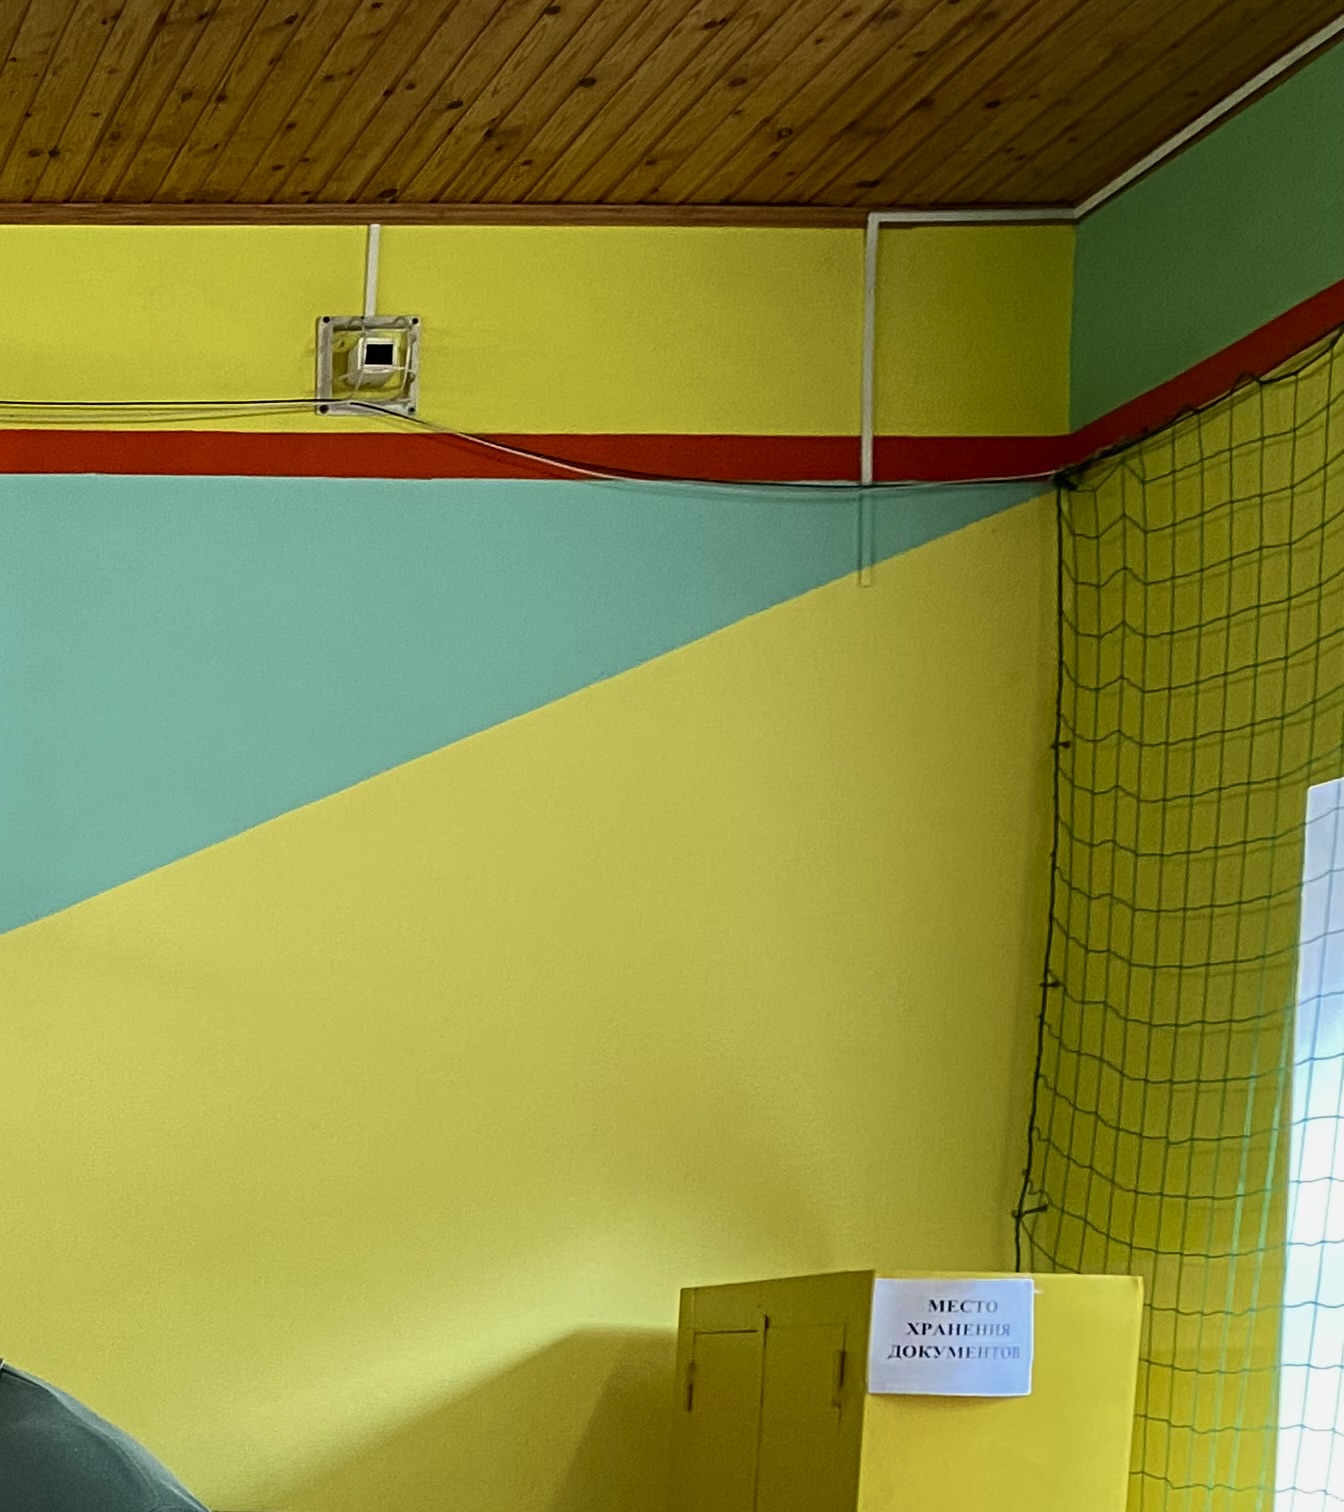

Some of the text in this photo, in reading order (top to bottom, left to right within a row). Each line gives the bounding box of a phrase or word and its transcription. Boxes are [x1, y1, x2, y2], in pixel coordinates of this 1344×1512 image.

[928, 1299, 998, 1313] МЕСТО
[907, 1322, 1011, 1336] ХРАНЕНИЯ
[887, 1345, 1021, 1360] ДОКУМЕНТОВ
